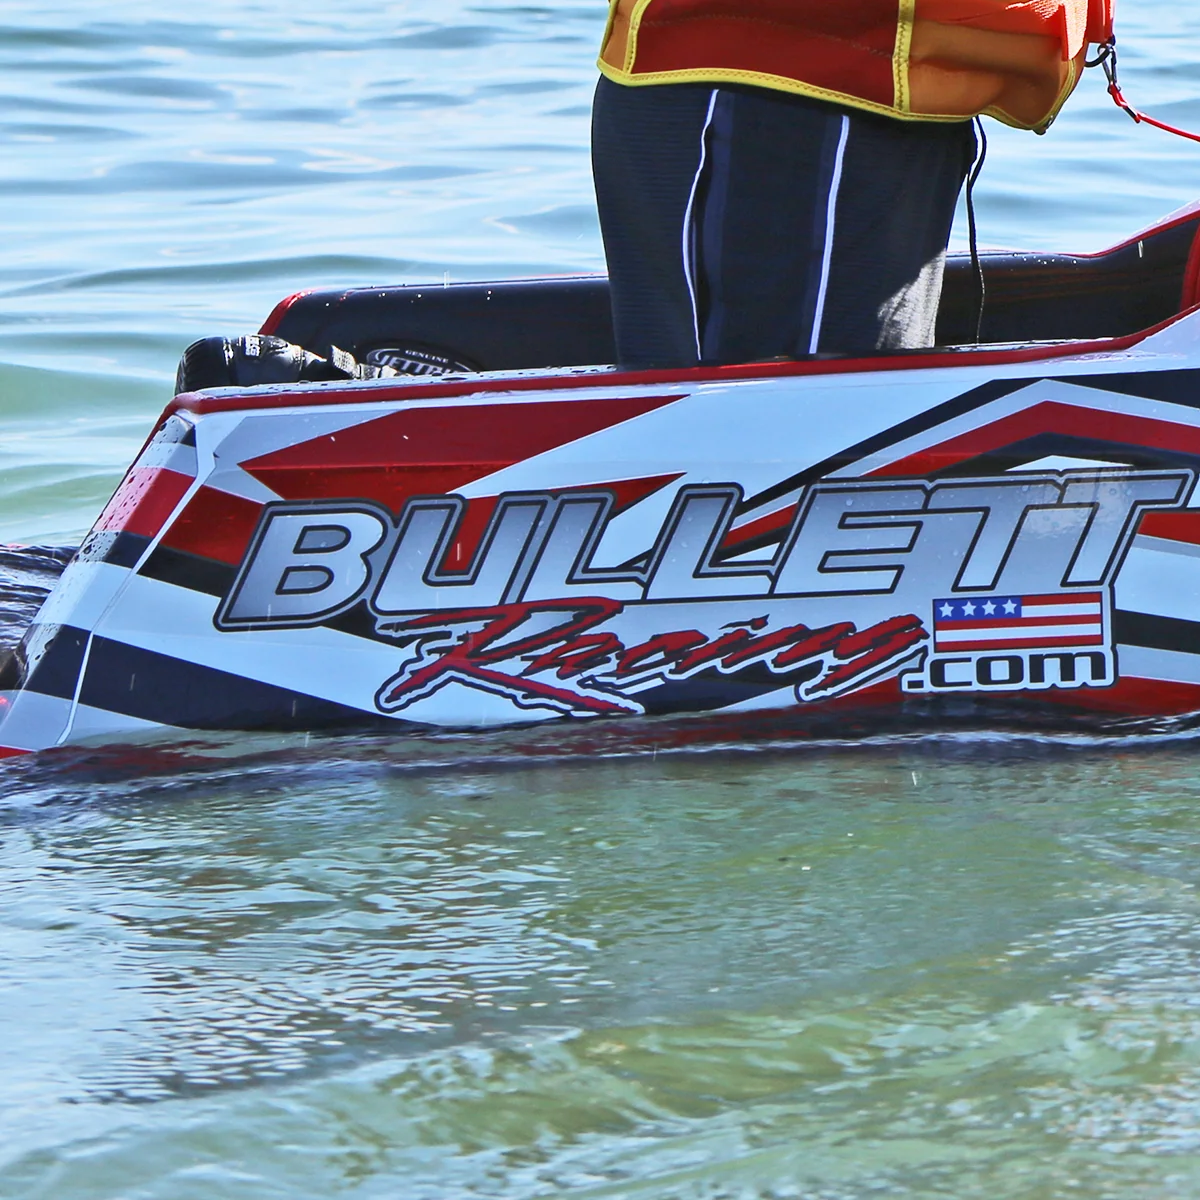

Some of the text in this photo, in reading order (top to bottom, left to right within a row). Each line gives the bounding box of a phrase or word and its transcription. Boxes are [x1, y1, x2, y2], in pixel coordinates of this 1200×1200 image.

[405, 350, 449, 363] GENUINE
[214, 471, 1196, 632] BULLETT
[376, 596, 930, 716] Racing
[904, 651, 1107, 690] .com
